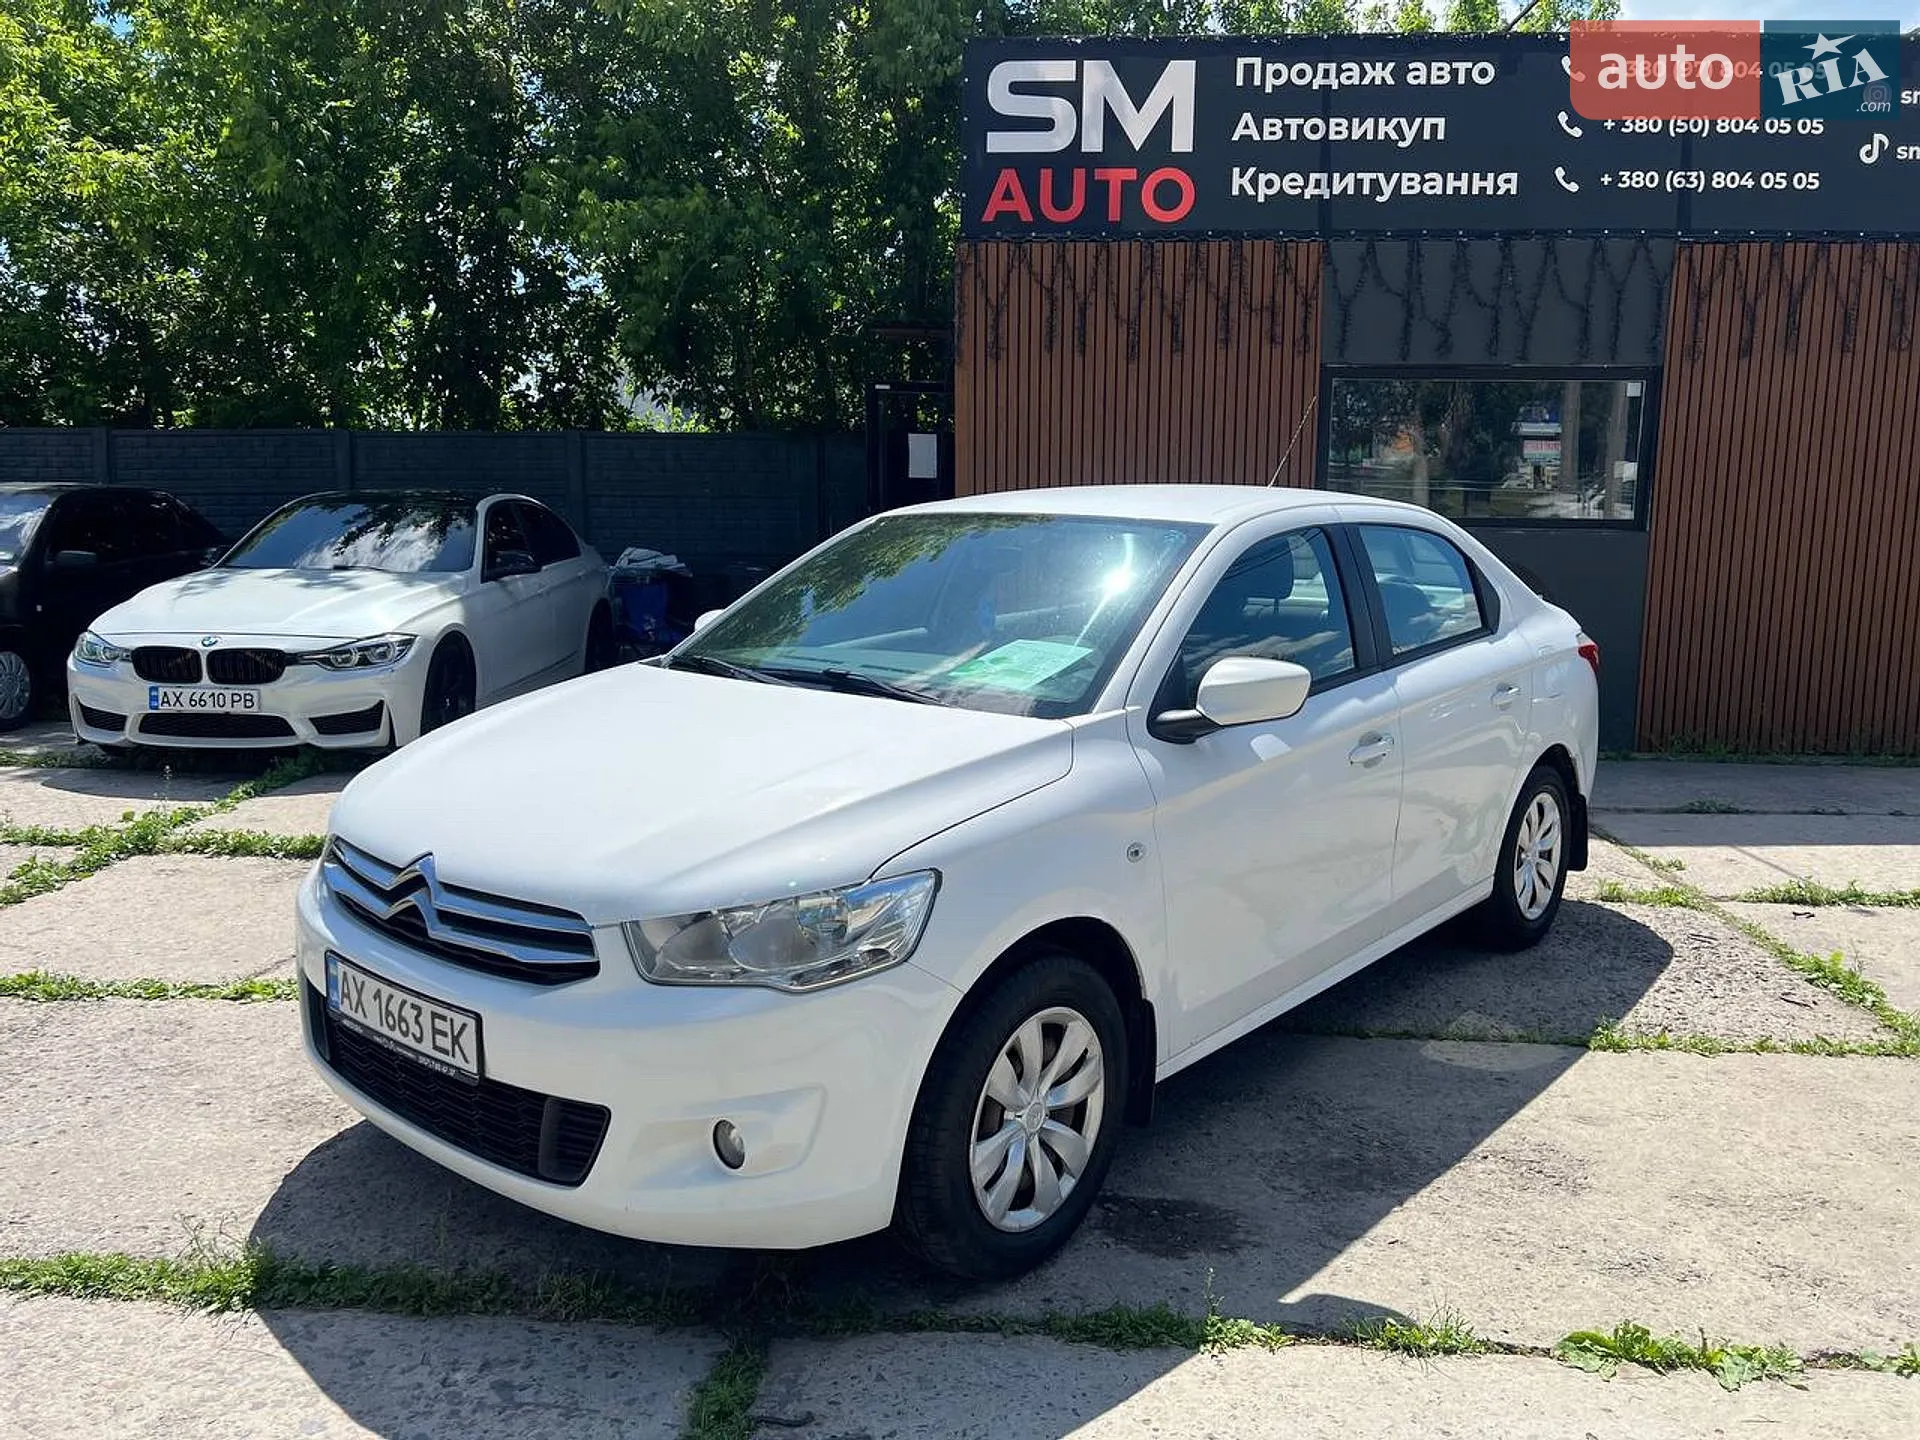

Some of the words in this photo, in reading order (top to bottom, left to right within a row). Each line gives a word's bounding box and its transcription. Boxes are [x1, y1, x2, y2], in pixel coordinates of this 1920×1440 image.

[1235, 56, 1395, 90] Продаж
[1406, 60, 1496, 86] авто
[986, 59, 1196, 153] SM
[1231, 112, 1446, 146] Автовикуп
[1621, 117, 1662, 133] 380
[1669, 117, 1710, 137] (50)
[1716, 117, 1759, 133] 804
[1765, 118, 1792, 134] 05
[1797, 118, 1824, 135] 05
[982, 167, 1197, 224] AUTO
[1231, 166, 1518, 202] Кредитування
[1618, 171, 1659, 188] 380
[1666, 171, 1706, 192] (63)
[1712, 172, 1755, 189] 804
[1760, 172, 1788, 189] 05
[1793, 172, 1820, 190] 05
[160, 691, 184, 708] AX
[189, 691, 226, 708] 6610
[231, 693, 255, 709] PB
[341, 970, 367, 1018] AX
[373, 988, 424, 1044] 1663
[430, 1010, 469, 1064] EK
